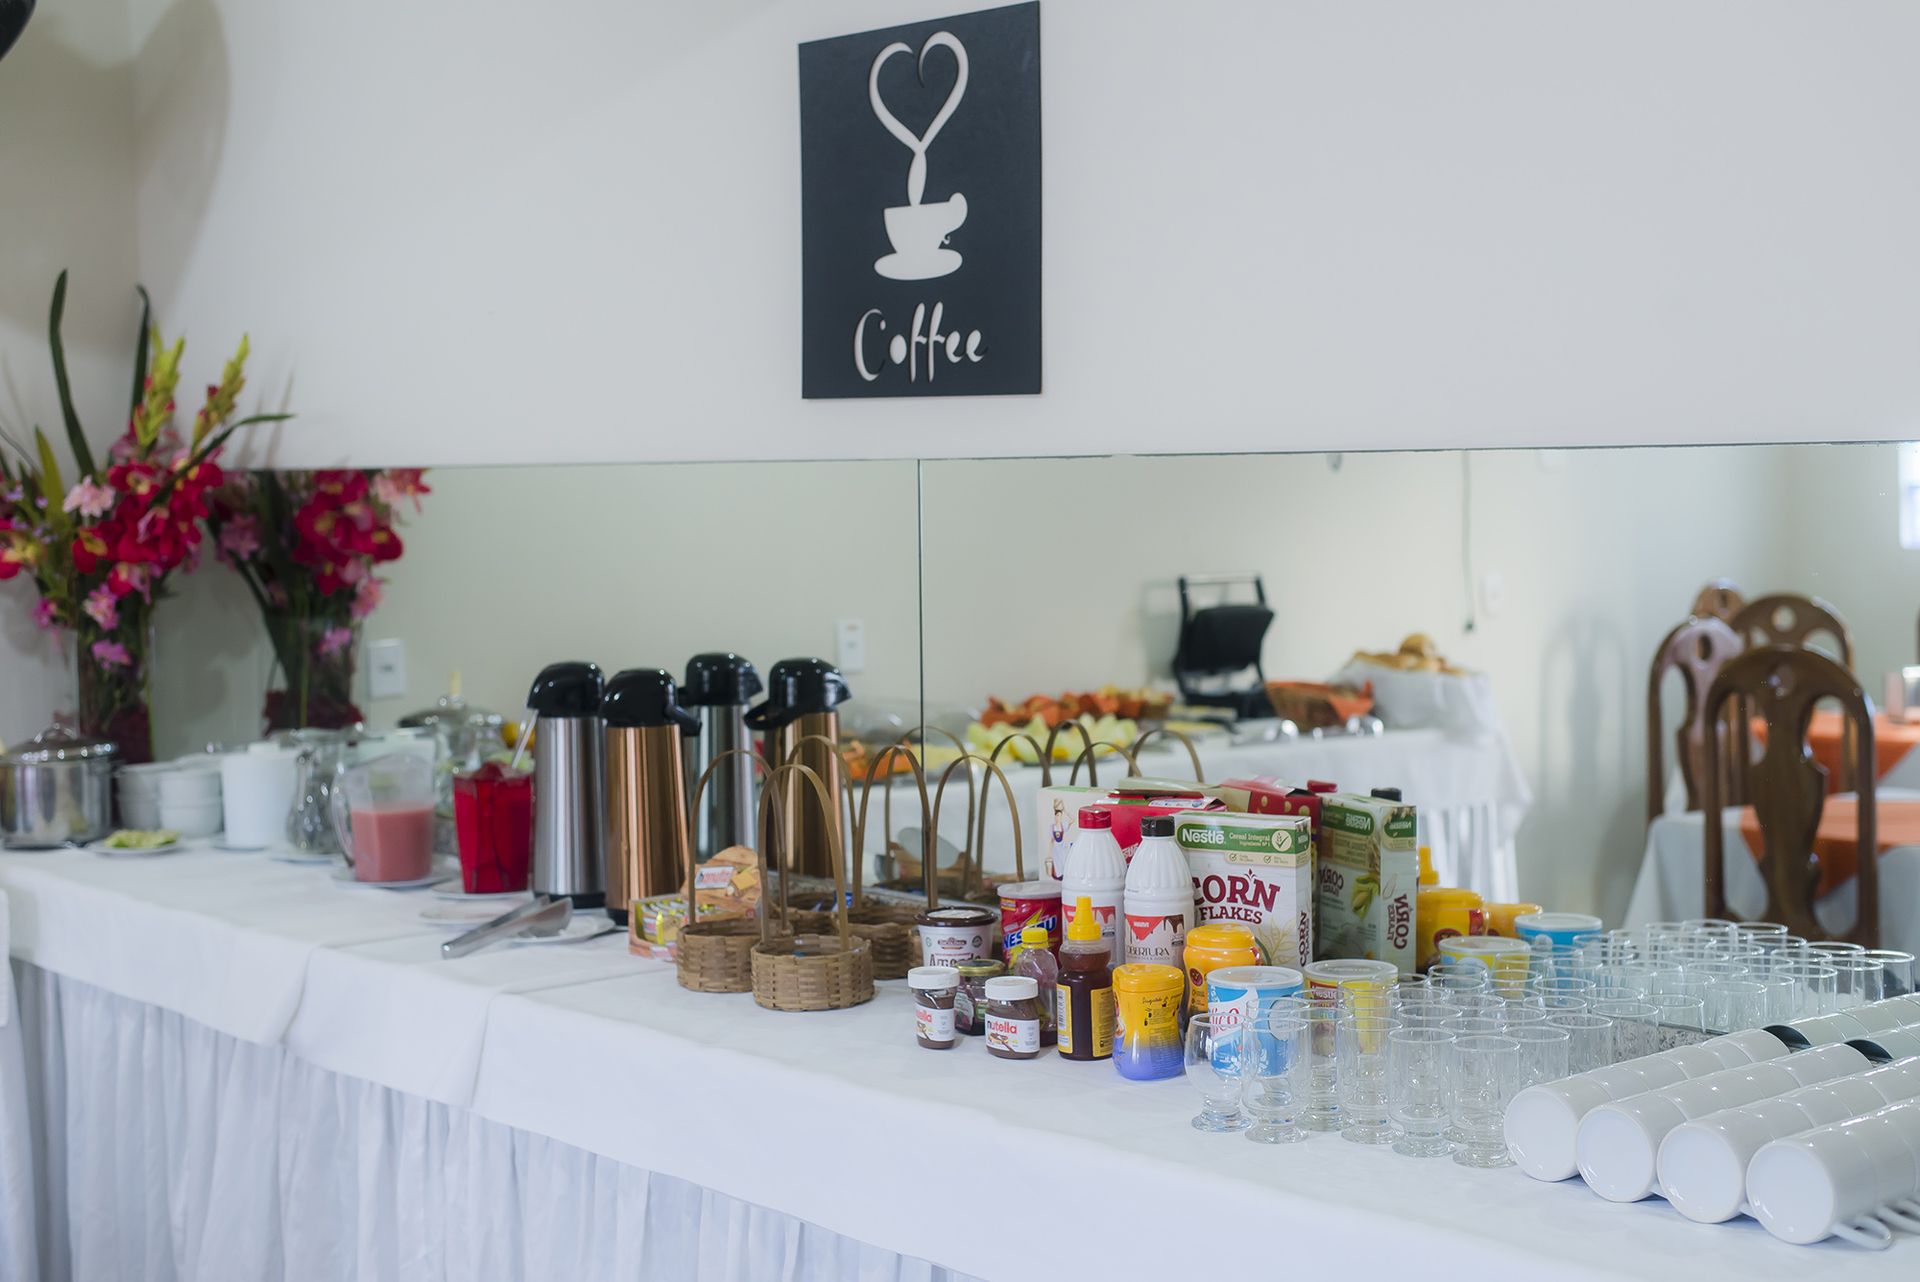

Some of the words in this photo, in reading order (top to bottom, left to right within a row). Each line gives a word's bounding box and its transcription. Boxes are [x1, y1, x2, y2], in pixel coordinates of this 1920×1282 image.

[854, 301, 988, 383] Coffee
[1199, 905, 1263, 925] FLAKES
[1004, 915, 1057, 949] NESU
[987, 1020, 1018, 1035] nutella
